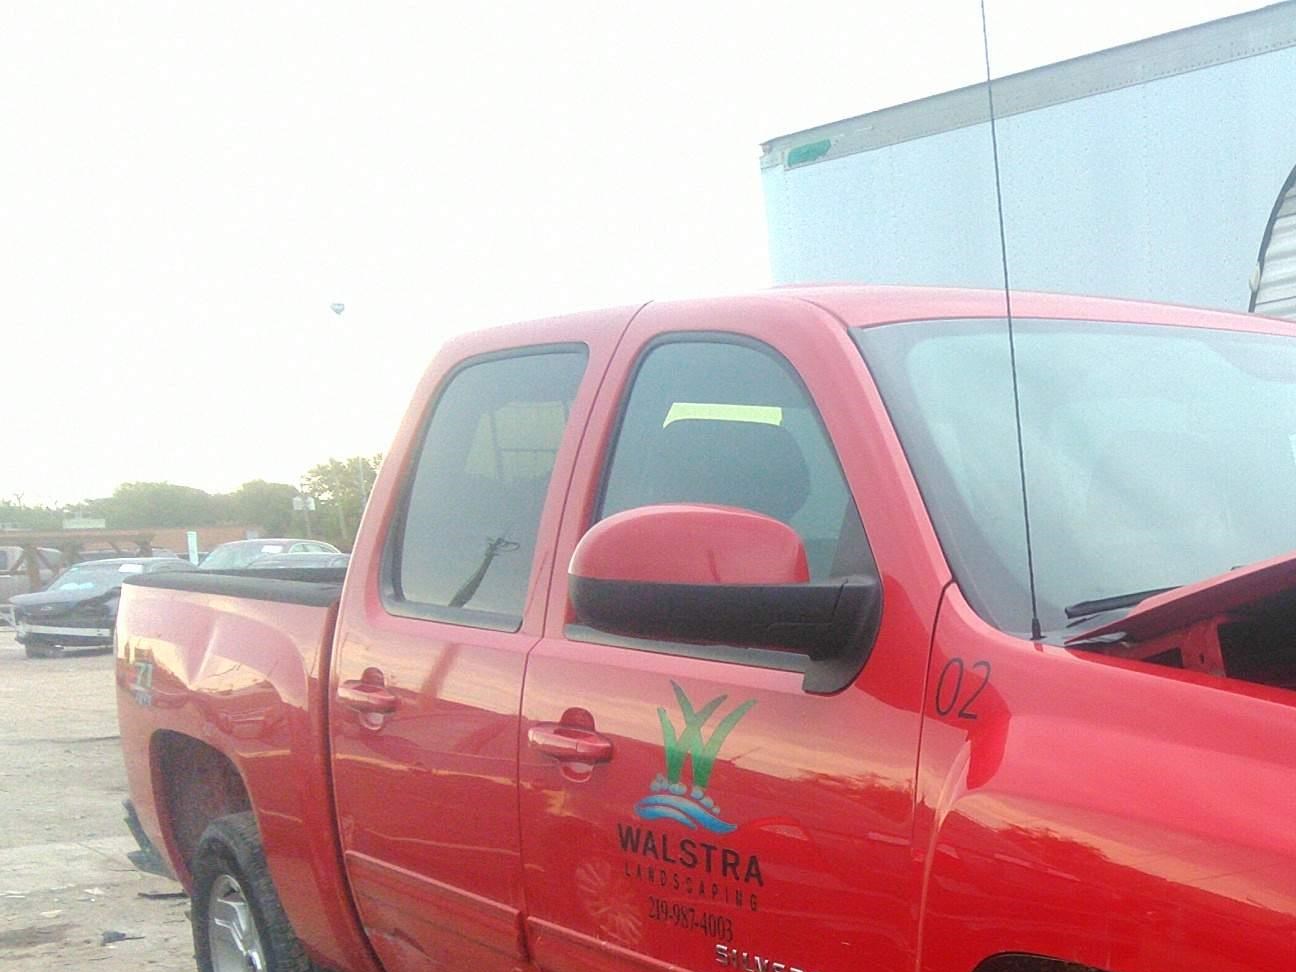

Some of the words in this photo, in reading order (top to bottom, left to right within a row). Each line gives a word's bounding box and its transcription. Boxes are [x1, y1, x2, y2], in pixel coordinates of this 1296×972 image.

[936, 657, 991, 719] 02
[617, 824, 764, 887] WALSTRA
[624, 862, 759, 912] LANDSCAPING
[648, 896, 734, 944] 219-987-4003
